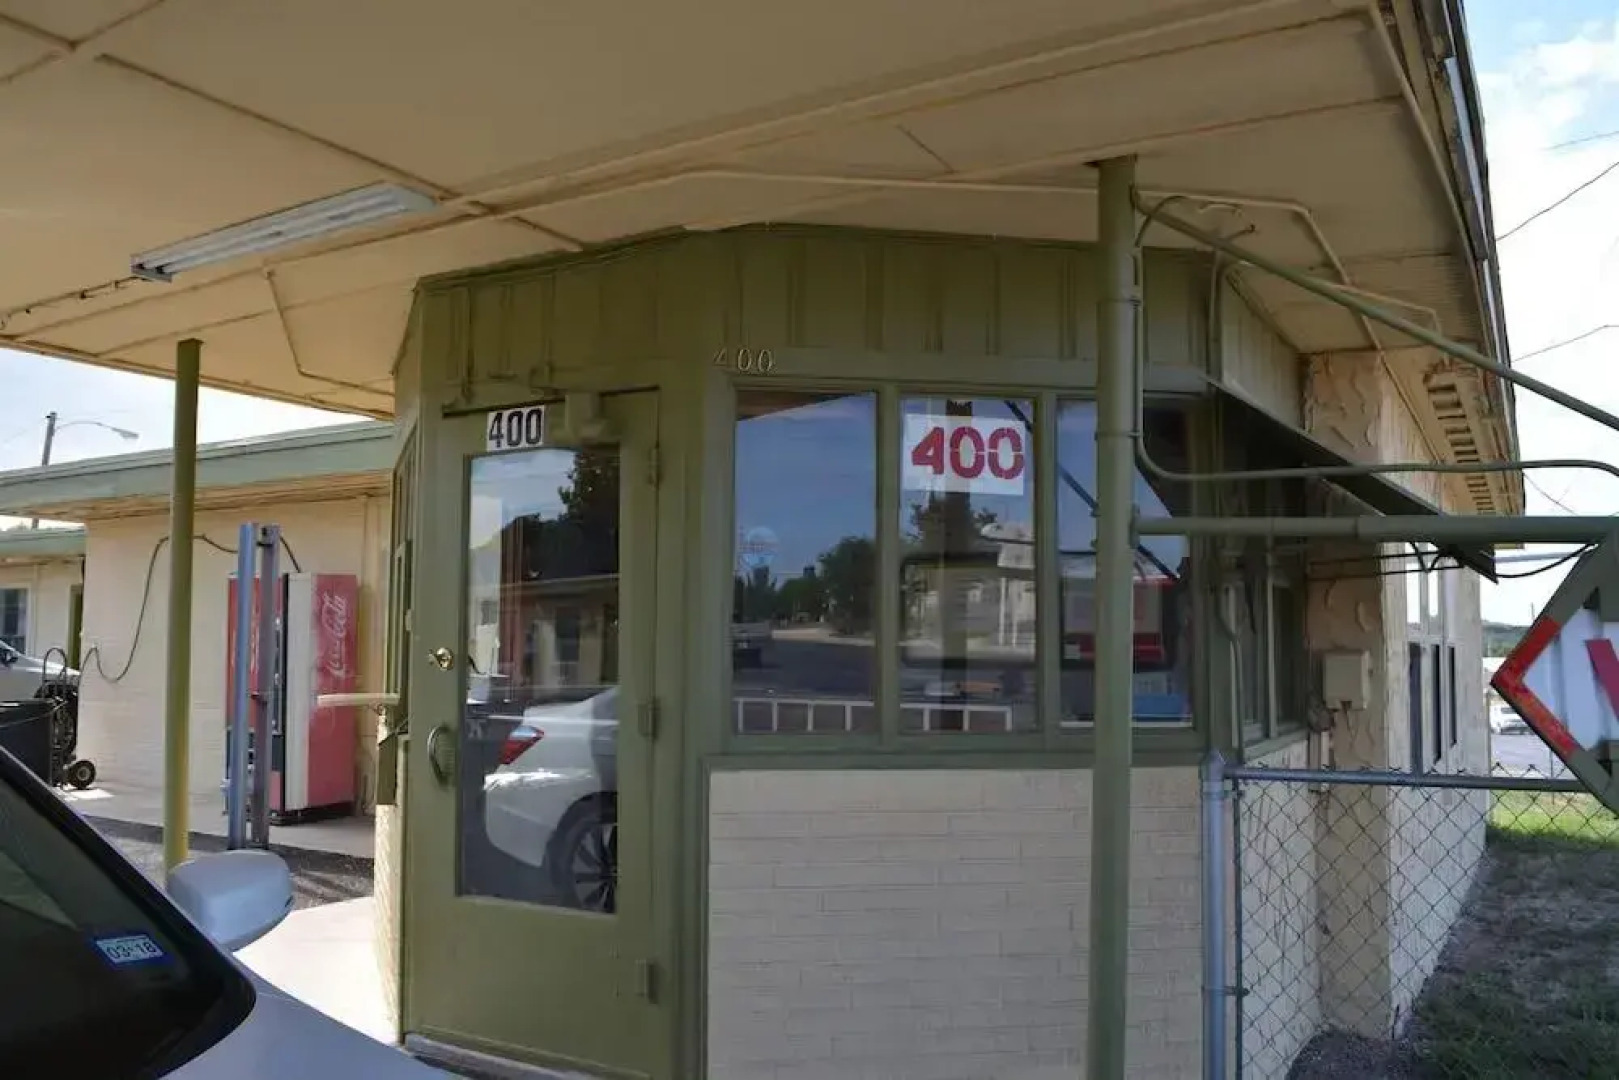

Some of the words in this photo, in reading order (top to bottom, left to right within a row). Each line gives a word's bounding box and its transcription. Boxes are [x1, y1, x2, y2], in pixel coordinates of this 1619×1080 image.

[713, 348, 773, 372] 400
[488, 409, 542, 448] 400
[912, 426, 1024, 479] 400
